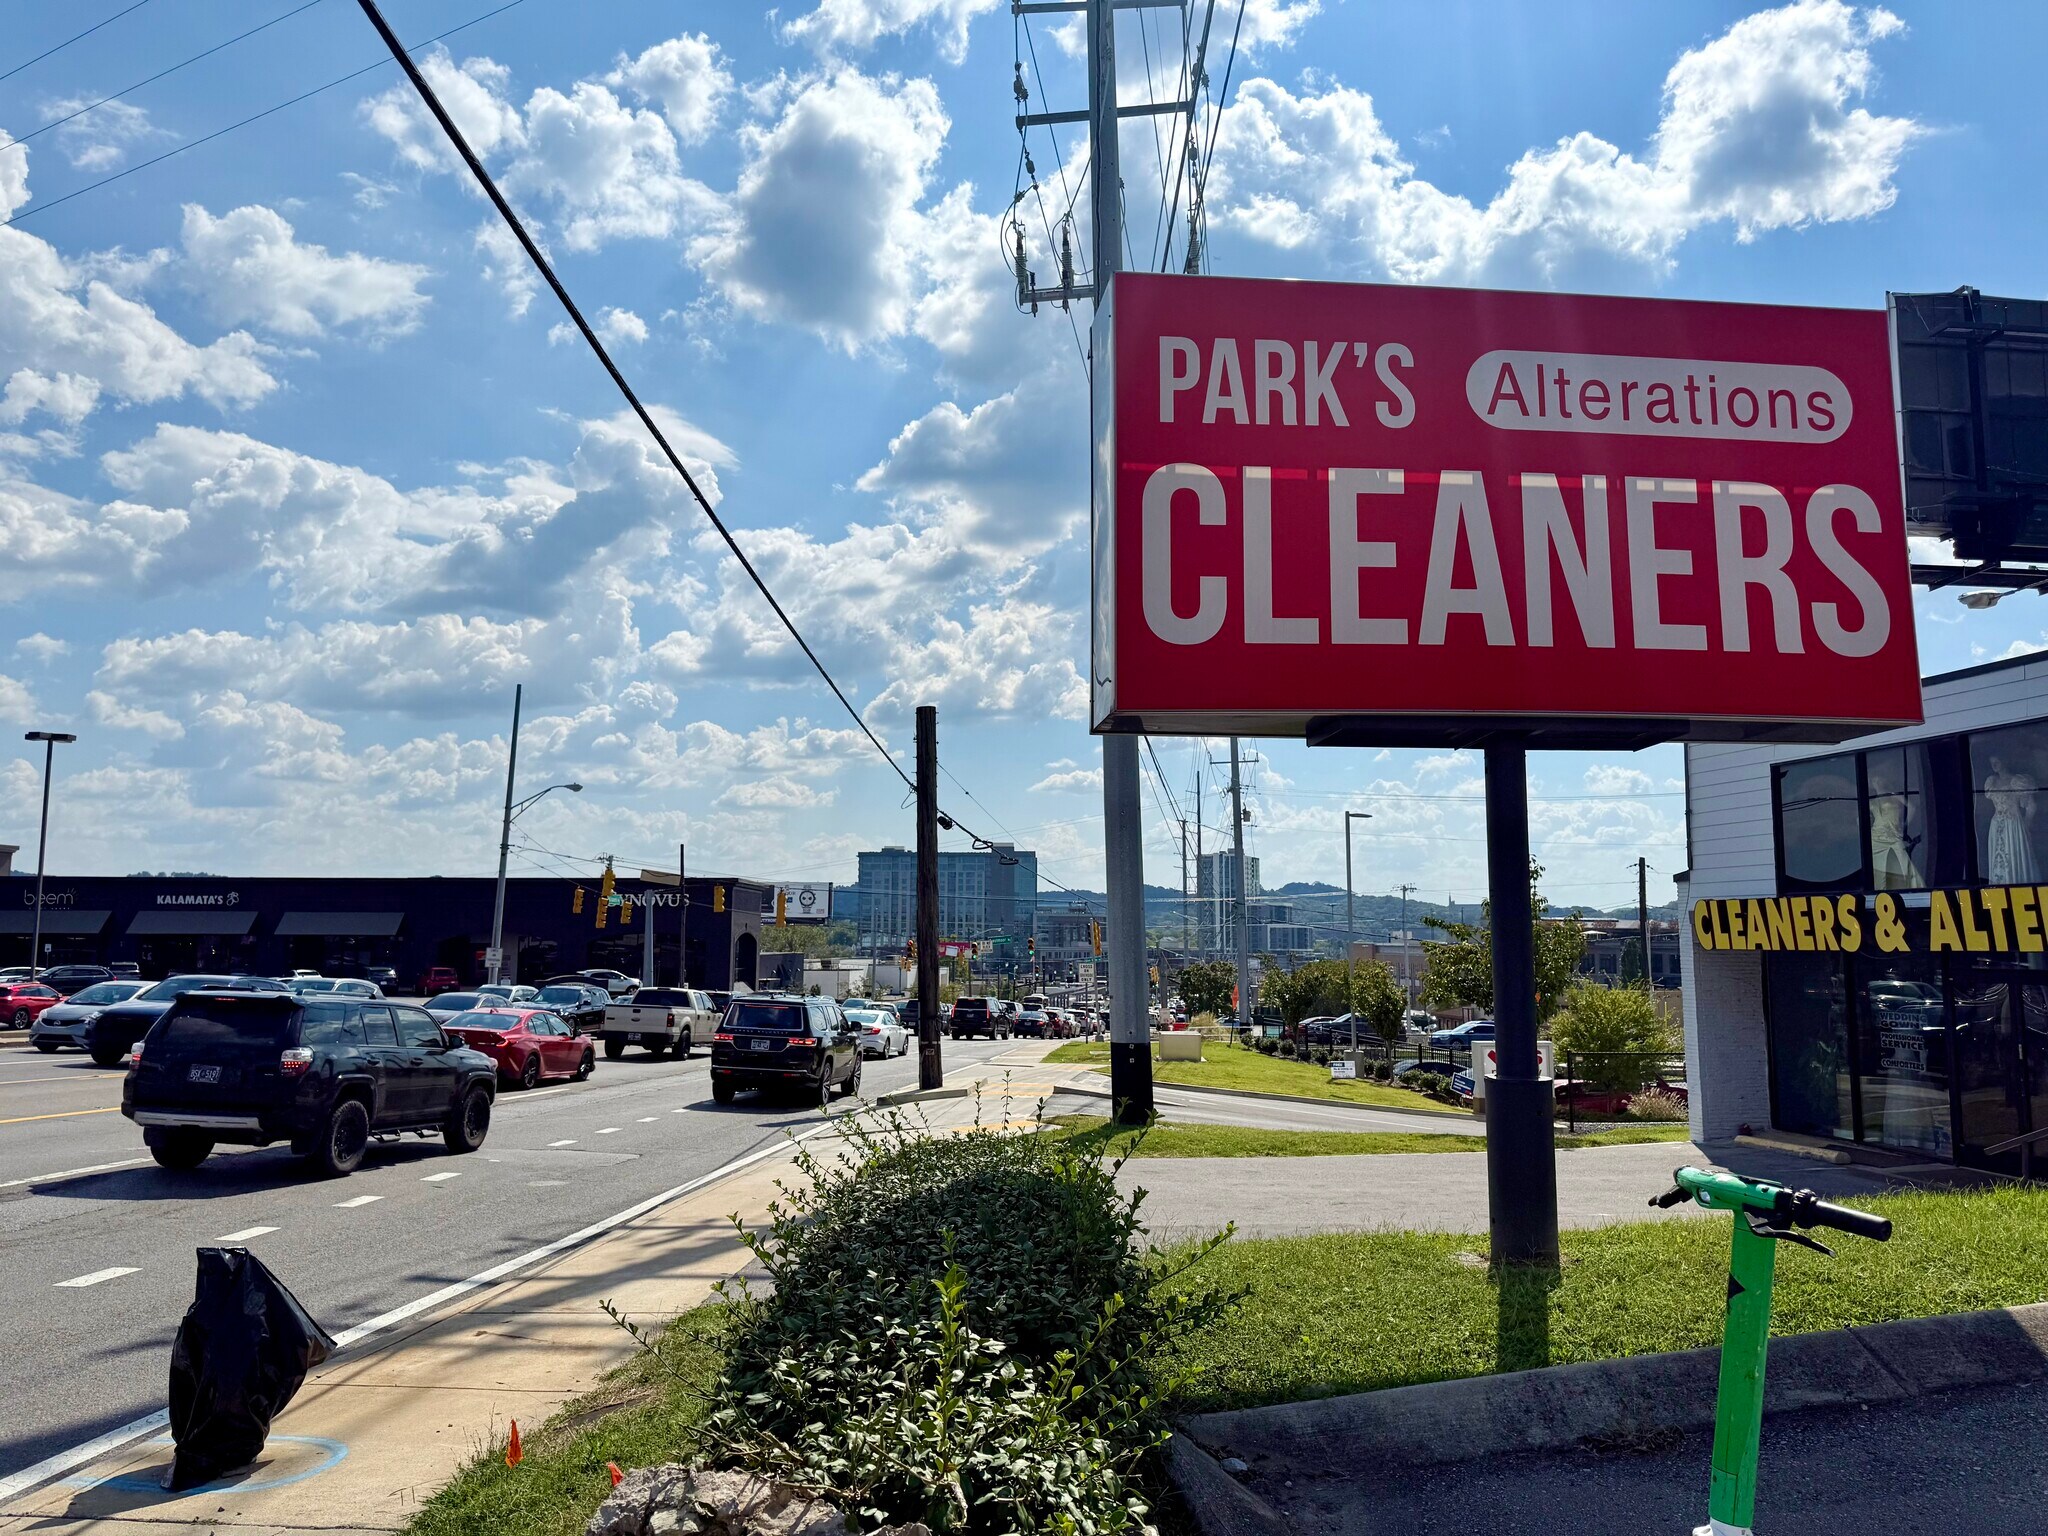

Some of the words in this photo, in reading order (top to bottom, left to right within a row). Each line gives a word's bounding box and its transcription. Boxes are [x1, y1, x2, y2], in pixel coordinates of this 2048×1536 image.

[1159, 336, 1416, 429] PARK'S
[1487, 360, 1837, 432] Alterations
[1142, 462, 1891, 657] CLEANERS
[156, 894, 224, 905] KALAMATA'S
[1693, 893, 1863, 952] CLEANERS
[1875, 892, 1910, 952] &
[1929, 886, 2048, 953] ALTE
[1880, 1012, 1928, 1022] WEDDING
[1881, 1040, 1925, 1051] SERVICE
